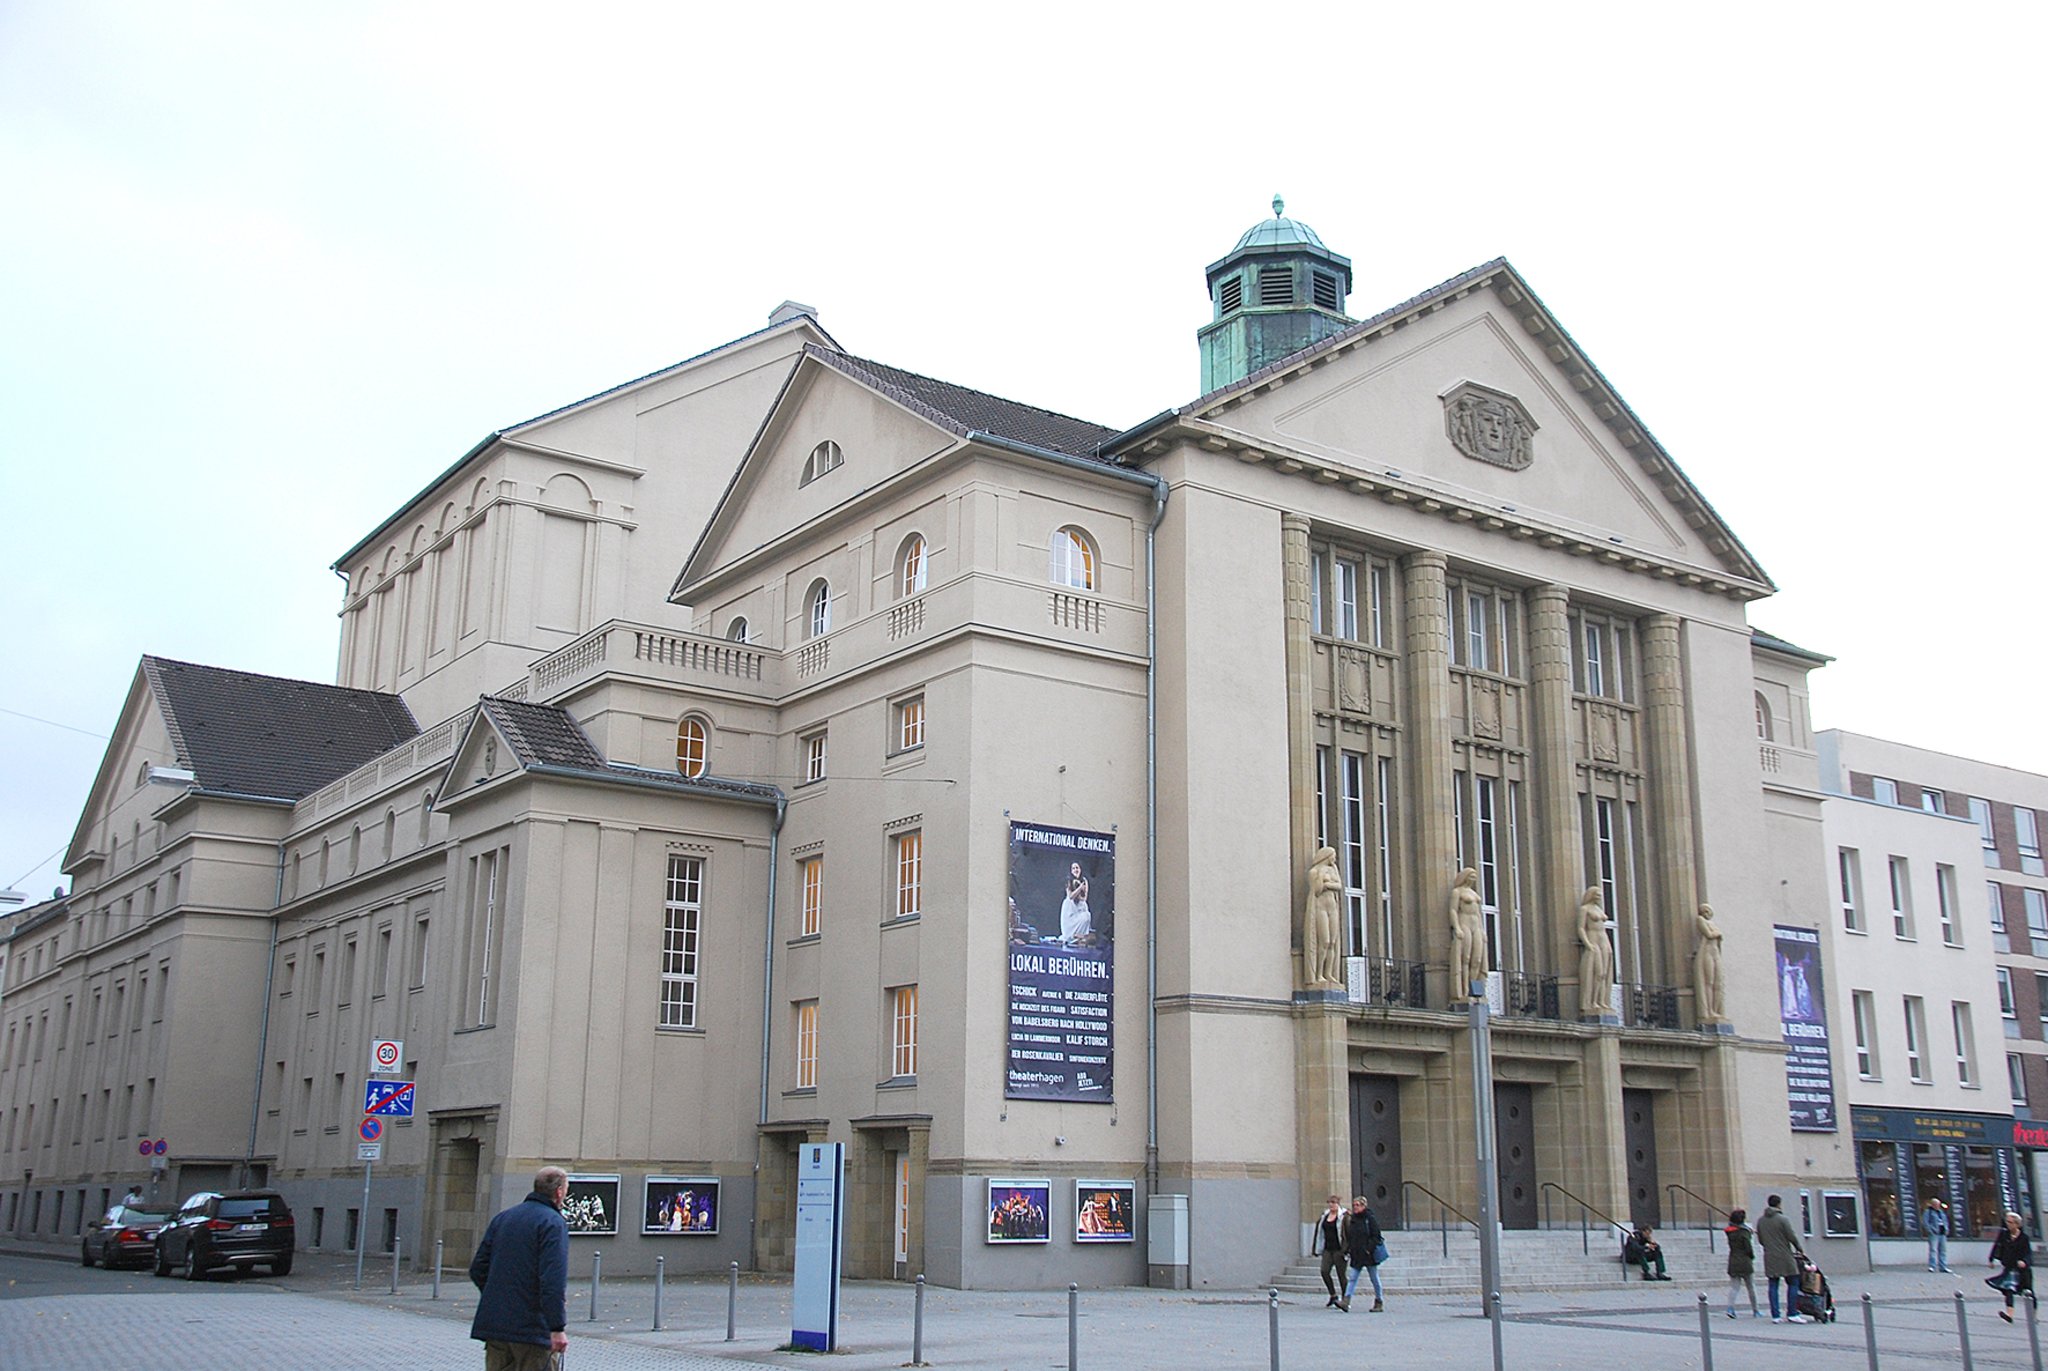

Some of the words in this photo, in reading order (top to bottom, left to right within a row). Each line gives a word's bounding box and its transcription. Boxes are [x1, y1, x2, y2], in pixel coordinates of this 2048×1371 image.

[1015, 828, 1076, 848] INTERNATIONAL
[1077, 836, 1111, 853] DENKEN.
[1011, 953, 1046, 974] LOKAL
[1048, 956, 1110, 979] BERÜHREN.
[1012, 984, 1038, 997] TSCHICK
[1070, 1005, 1108, 1017] SATISFACTION
[1060, 1018, 1074, 1029] NACH
[1075, 1019, 1108, 1031] HOLLYWOOD
[1066, 1034, 1084, 1045] KALIF
[1084, 1035, 1108, 1047] STORCH
[381, 1048, 394, 1059] 30
[1009, 1069, 1064, 1085] theaterhagen
